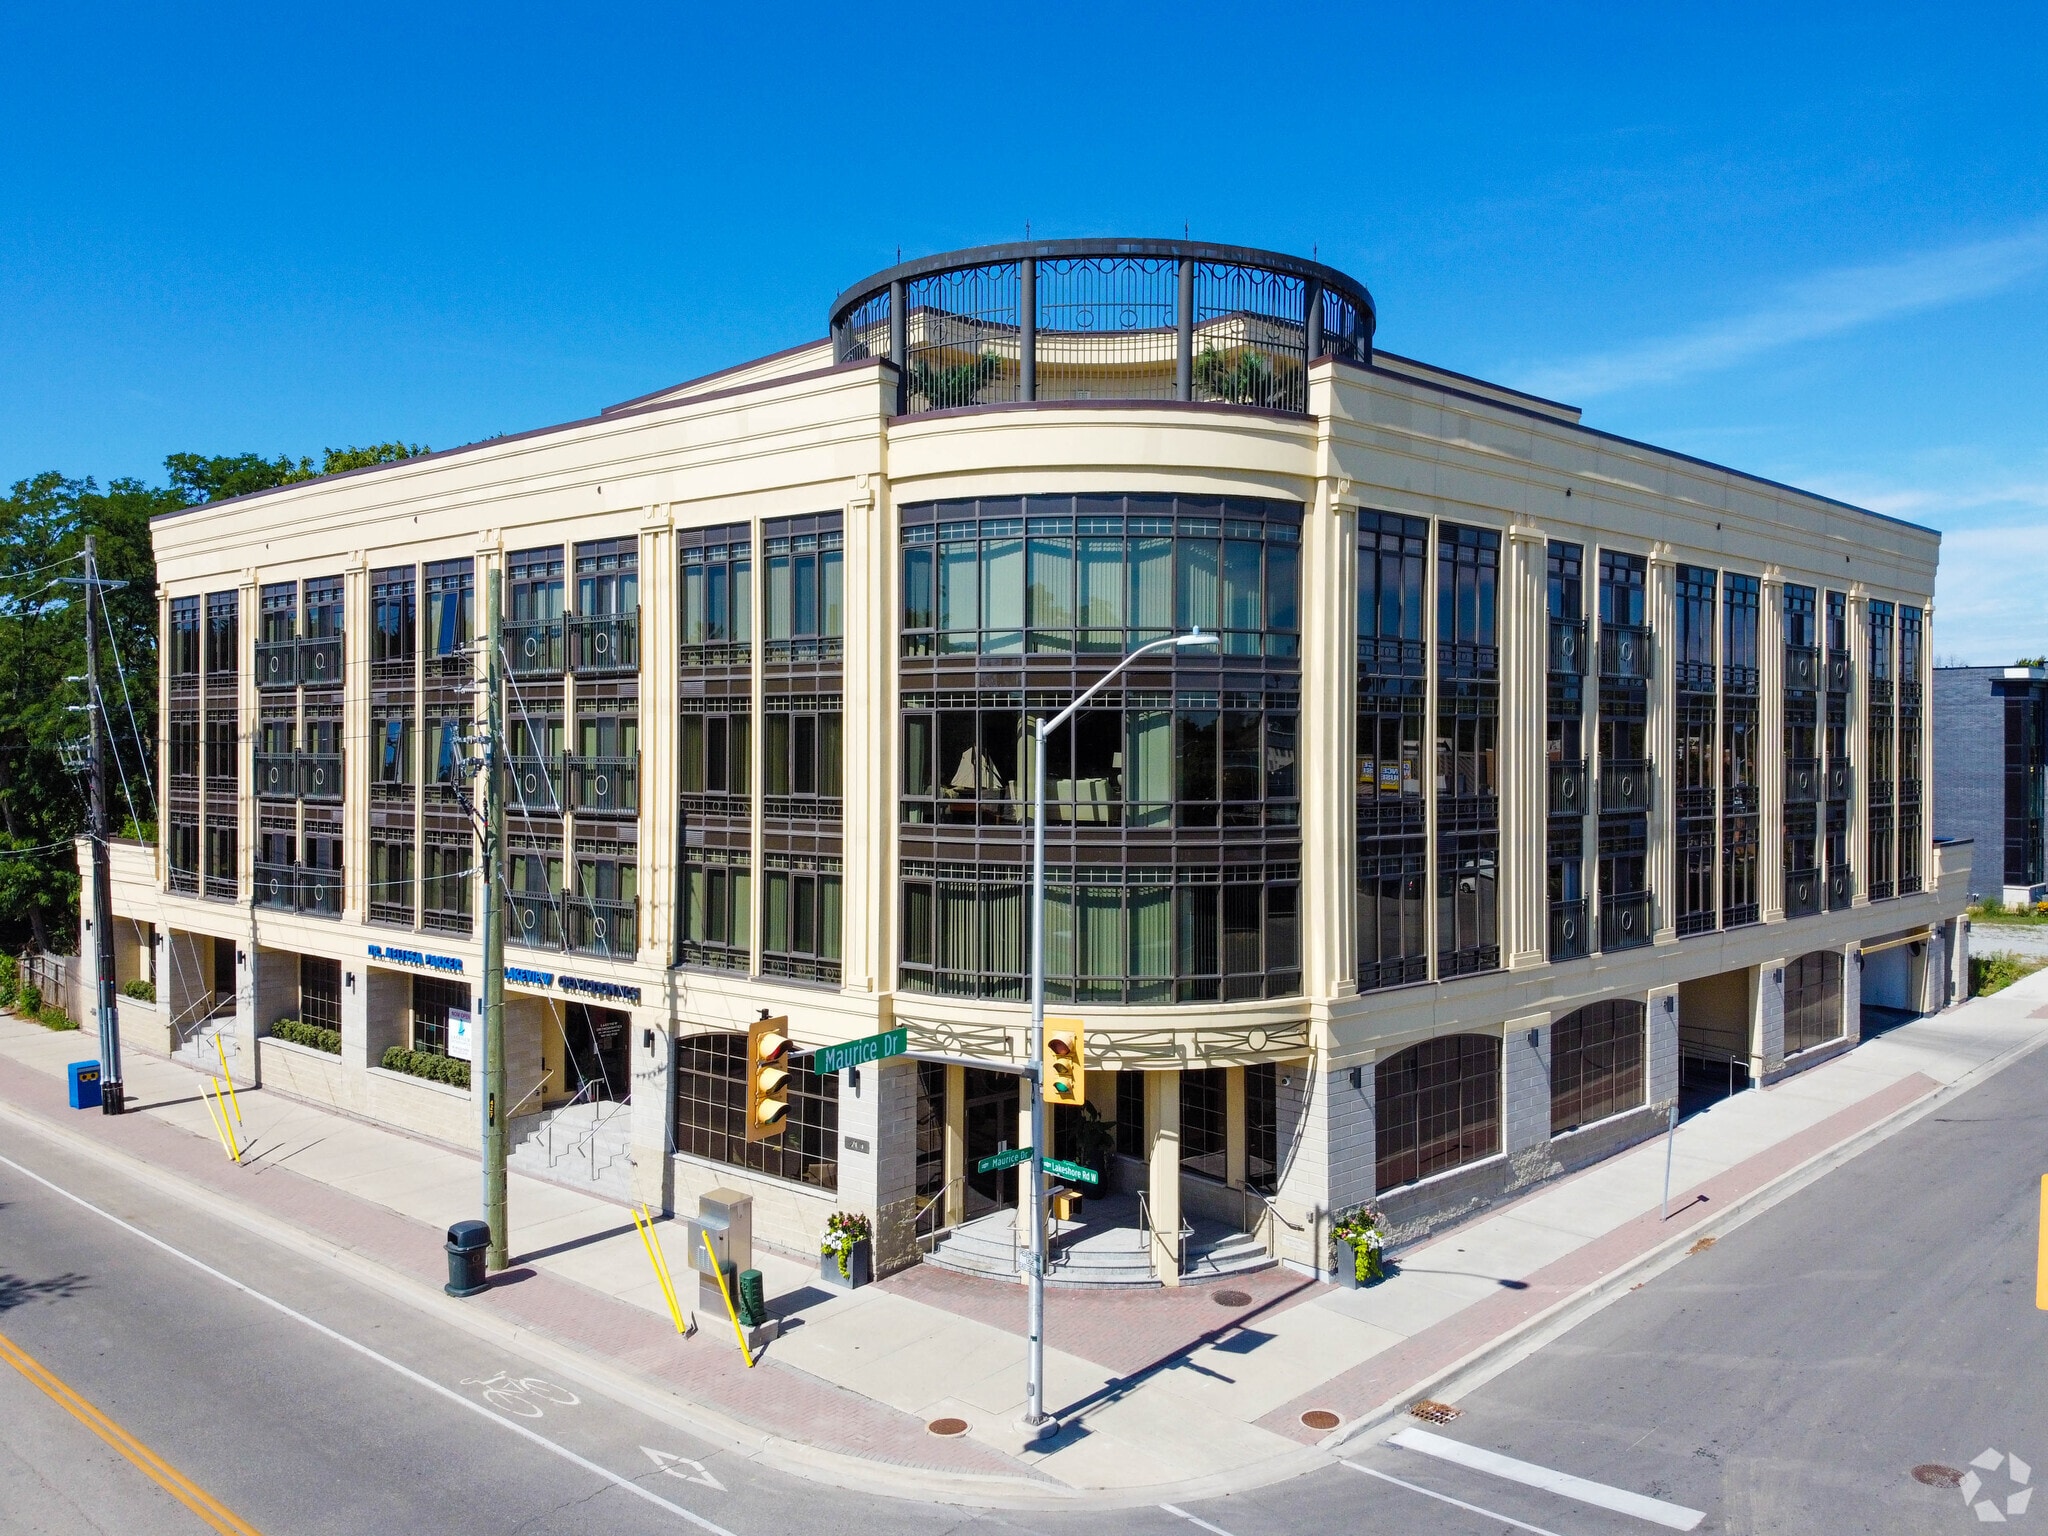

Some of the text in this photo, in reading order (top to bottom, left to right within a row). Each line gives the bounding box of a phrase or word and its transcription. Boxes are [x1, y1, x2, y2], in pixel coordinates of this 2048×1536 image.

[368, 945, 463, 971] DR. MELISSA PARKER
[504, 967, 641, 1001] LAKEVIEW ORTHODONTICS
[825, 1034, 898, 1072] Maurice Dr
[992, 1154, 1019, 1168] Maurice
[1020, 1151, 1028, 1160] Dr
[1052, 1162, 1081, 1178] Lakeshore
[1082, 1170, 1090, 1181] Rd
[1091, 1173, 1097, 1183] W
